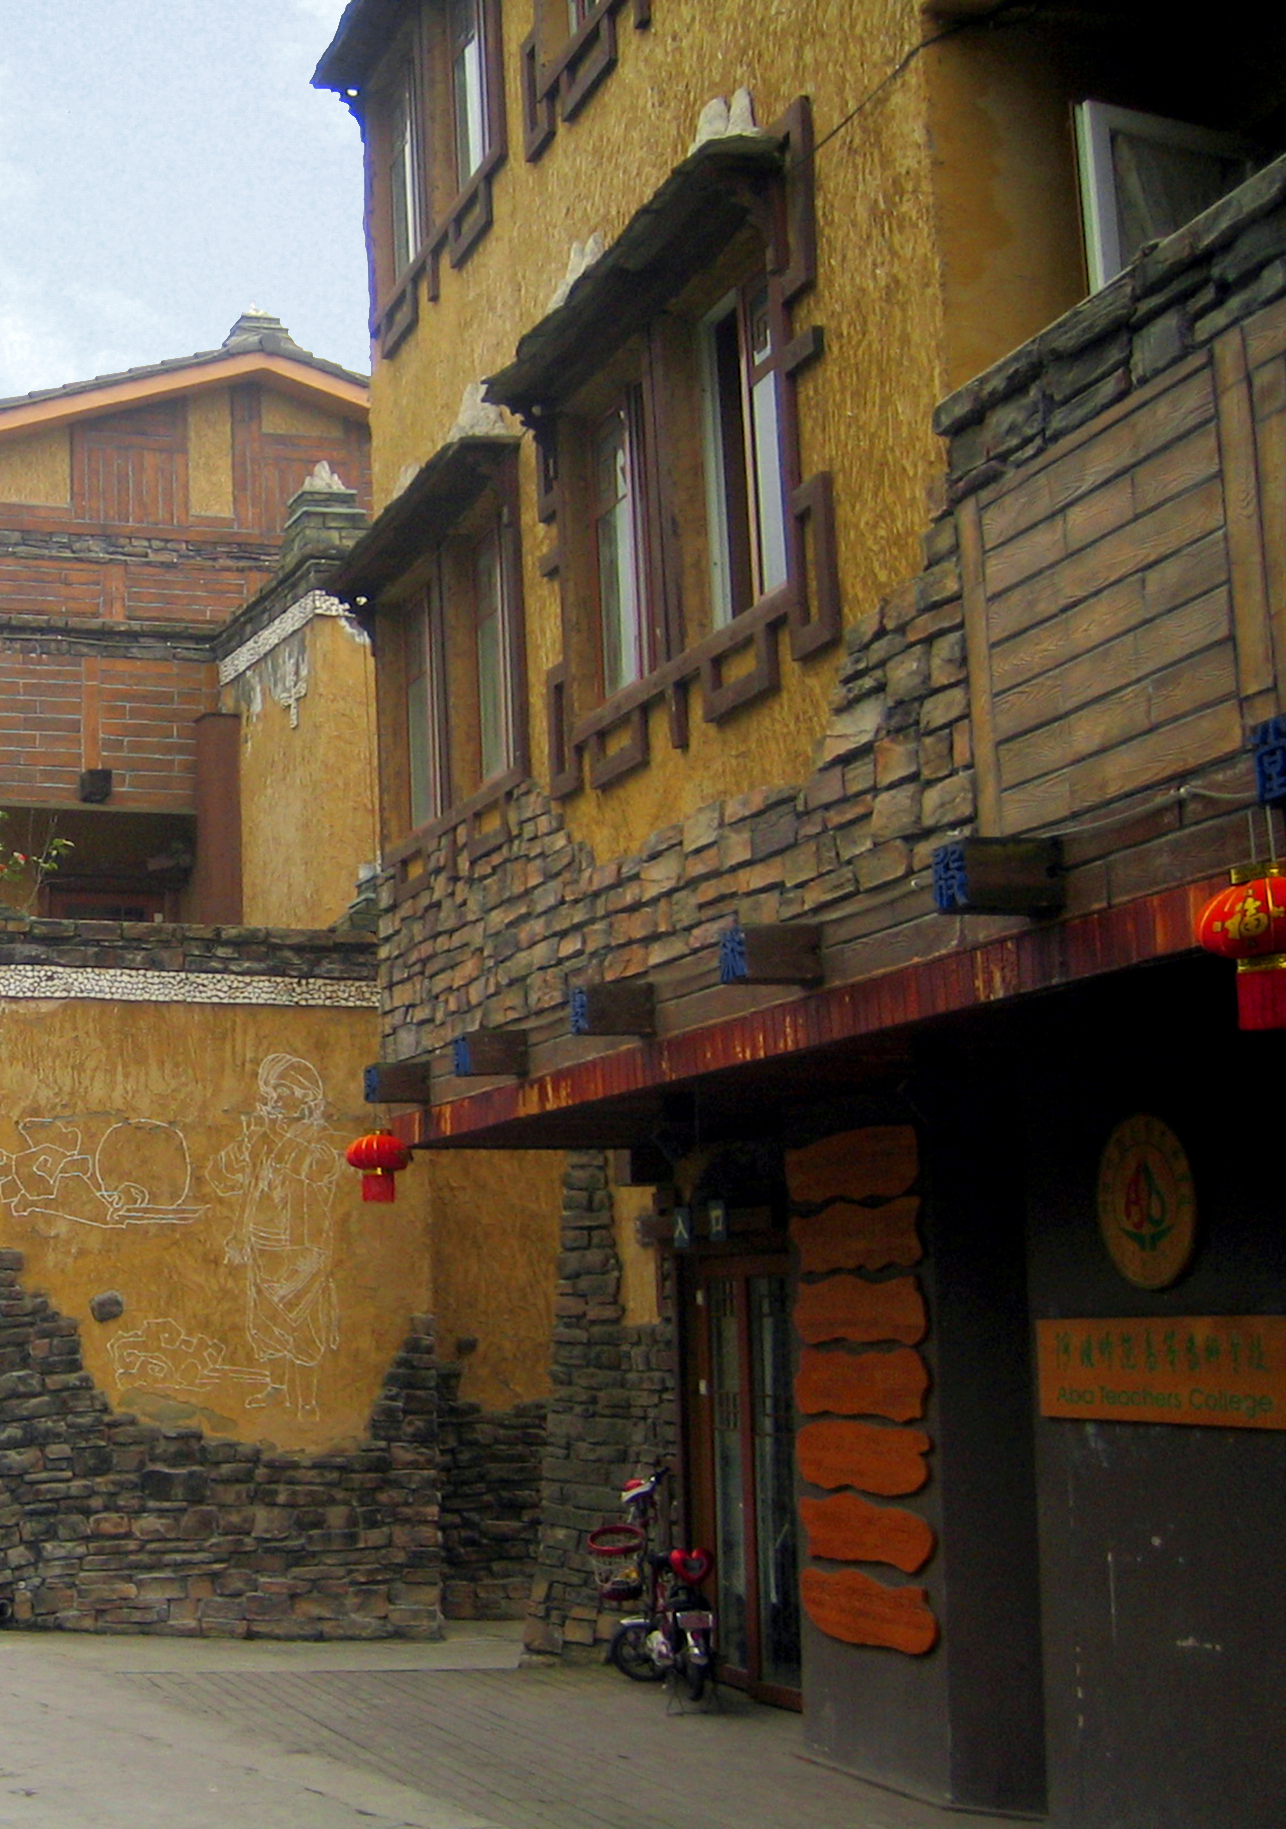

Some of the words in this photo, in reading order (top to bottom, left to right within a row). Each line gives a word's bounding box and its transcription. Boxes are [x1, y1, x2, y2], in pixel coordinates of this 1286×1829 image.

[1056, 1386, 1095, 1405] Aba
[1099, 1385, 1182, 1408] Teachers
[1188, 1387, 1275, 1418] College
